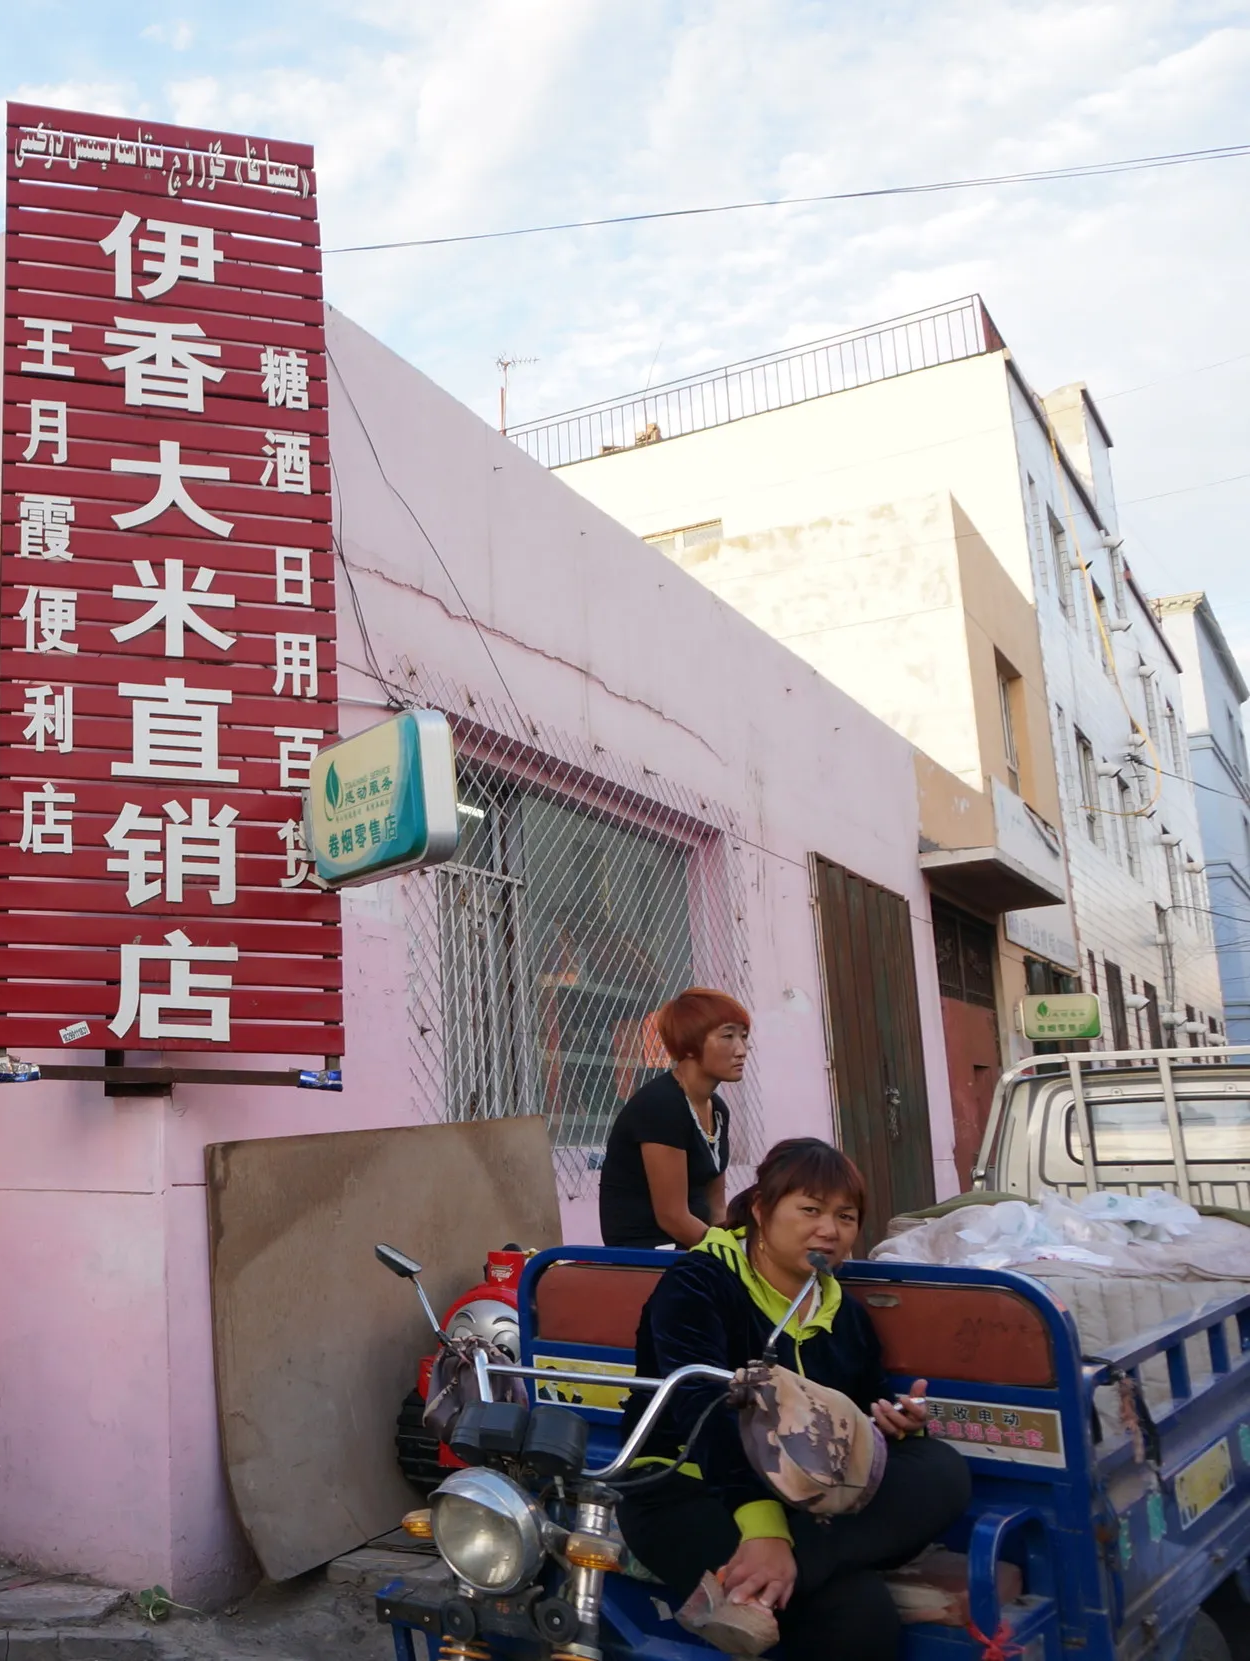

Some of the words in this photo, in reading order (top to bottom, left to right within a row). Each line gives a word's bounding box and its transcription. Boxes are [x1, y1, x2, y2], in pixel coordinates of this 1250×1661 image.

[18, 318, 79, 855] 王月霞便利店
[99, 210, 240, 1042] 伊香大米直销店
[329, 813, 397, 858] 卷烟零售店
[929, 1404, 1020, 1425] 丰收电动
